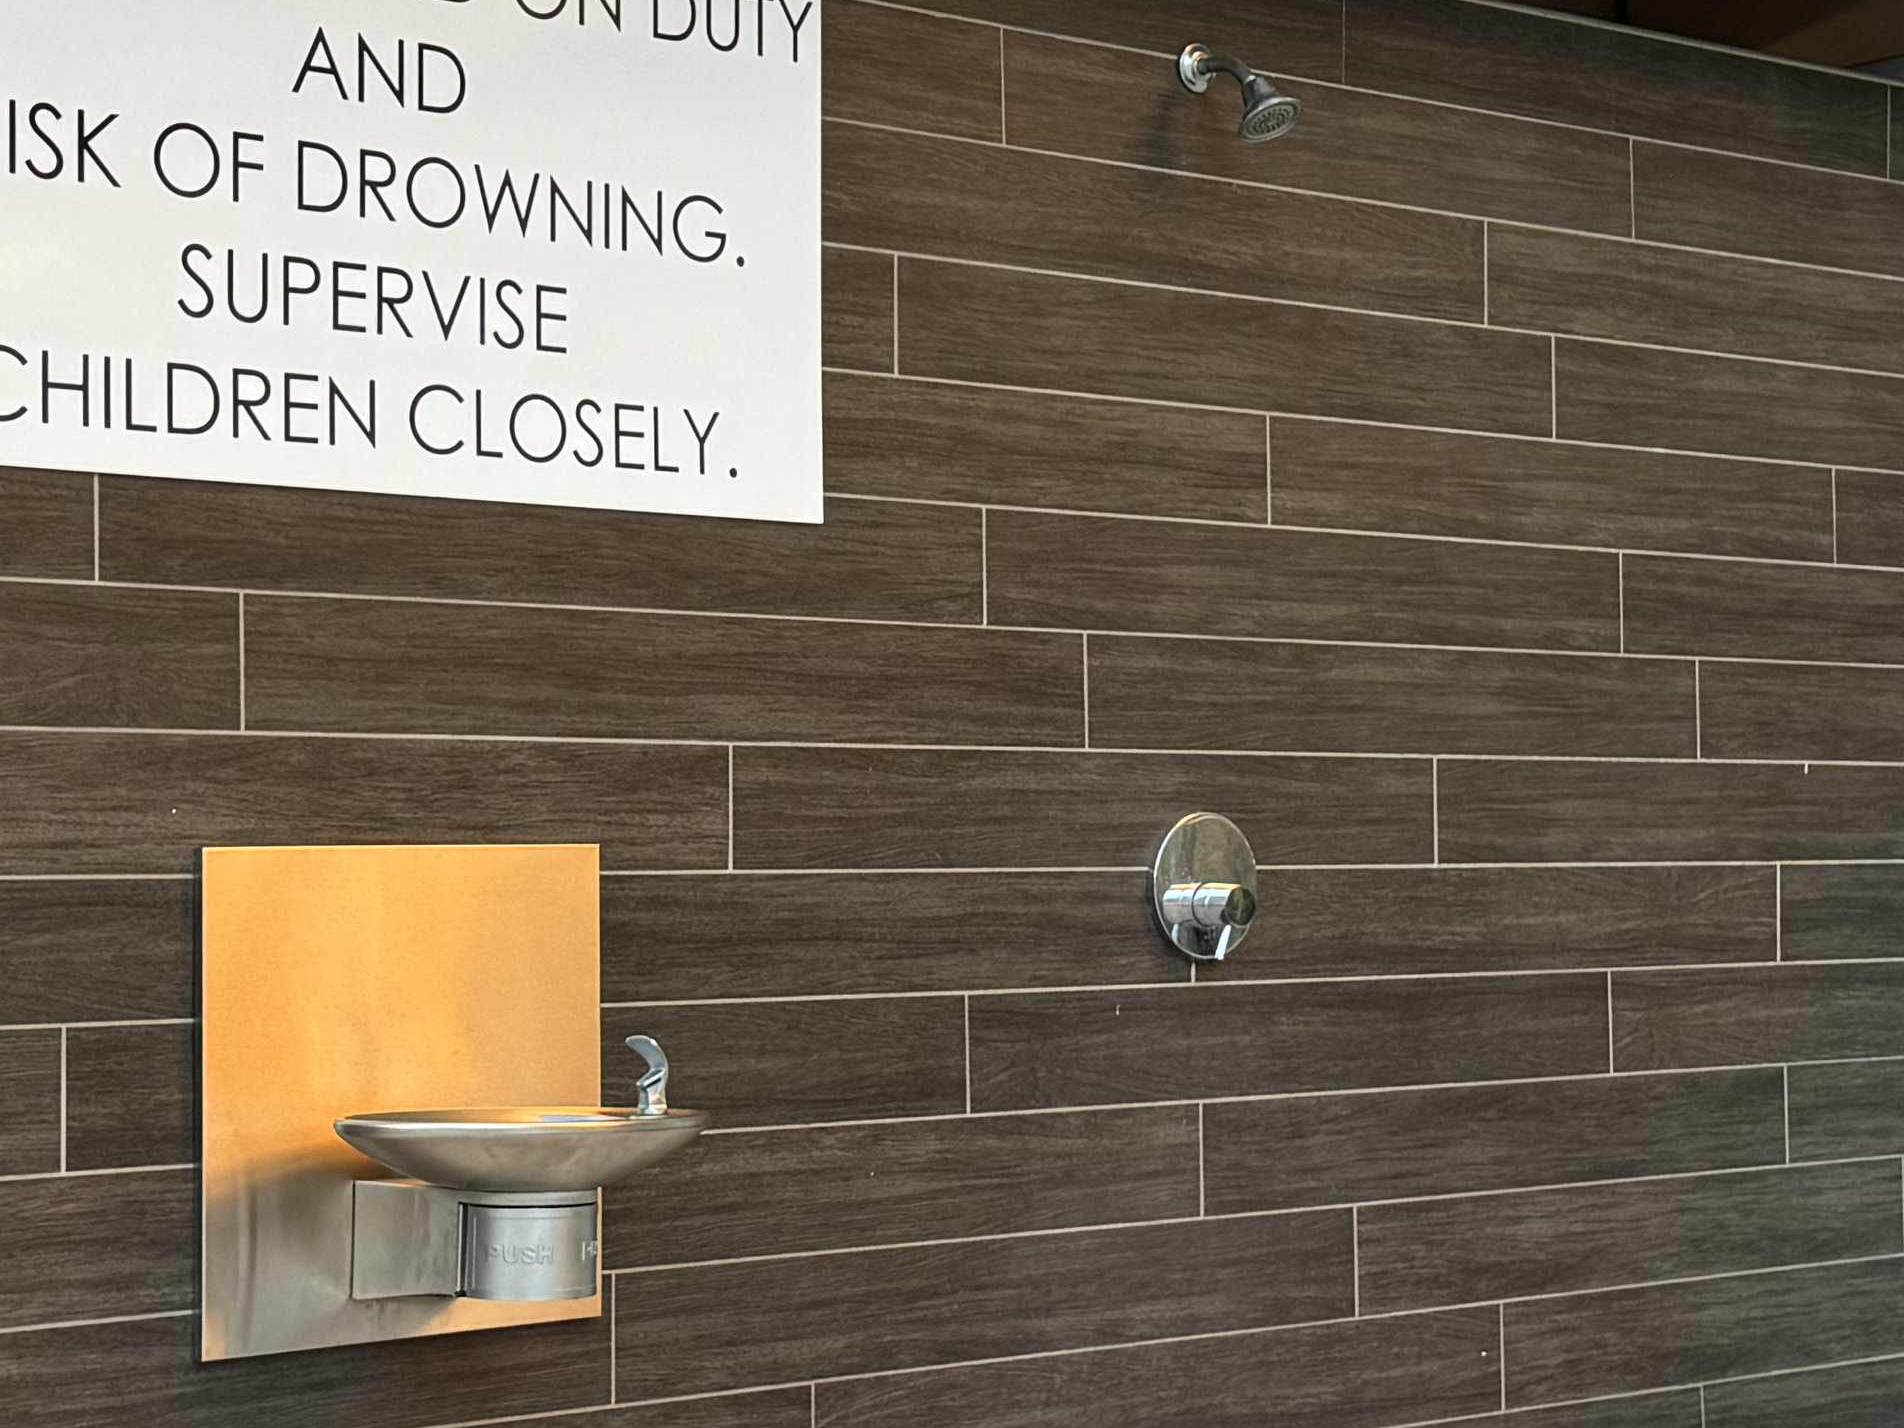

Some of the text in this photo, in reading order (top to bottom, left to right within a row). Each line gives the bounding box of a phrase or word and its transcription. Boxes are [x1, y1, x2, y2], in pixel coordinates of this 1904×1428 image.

[292, 26, 466, 114] AND
[153, 122, 264, 203] OF
[297, 140, 745, 267] DROWNING.
[177, 243, 567, 354] SUPERVISE
[409, 384, 738, 478] CLOSELY.
[484, 1243, 555, 1266] PUSH
